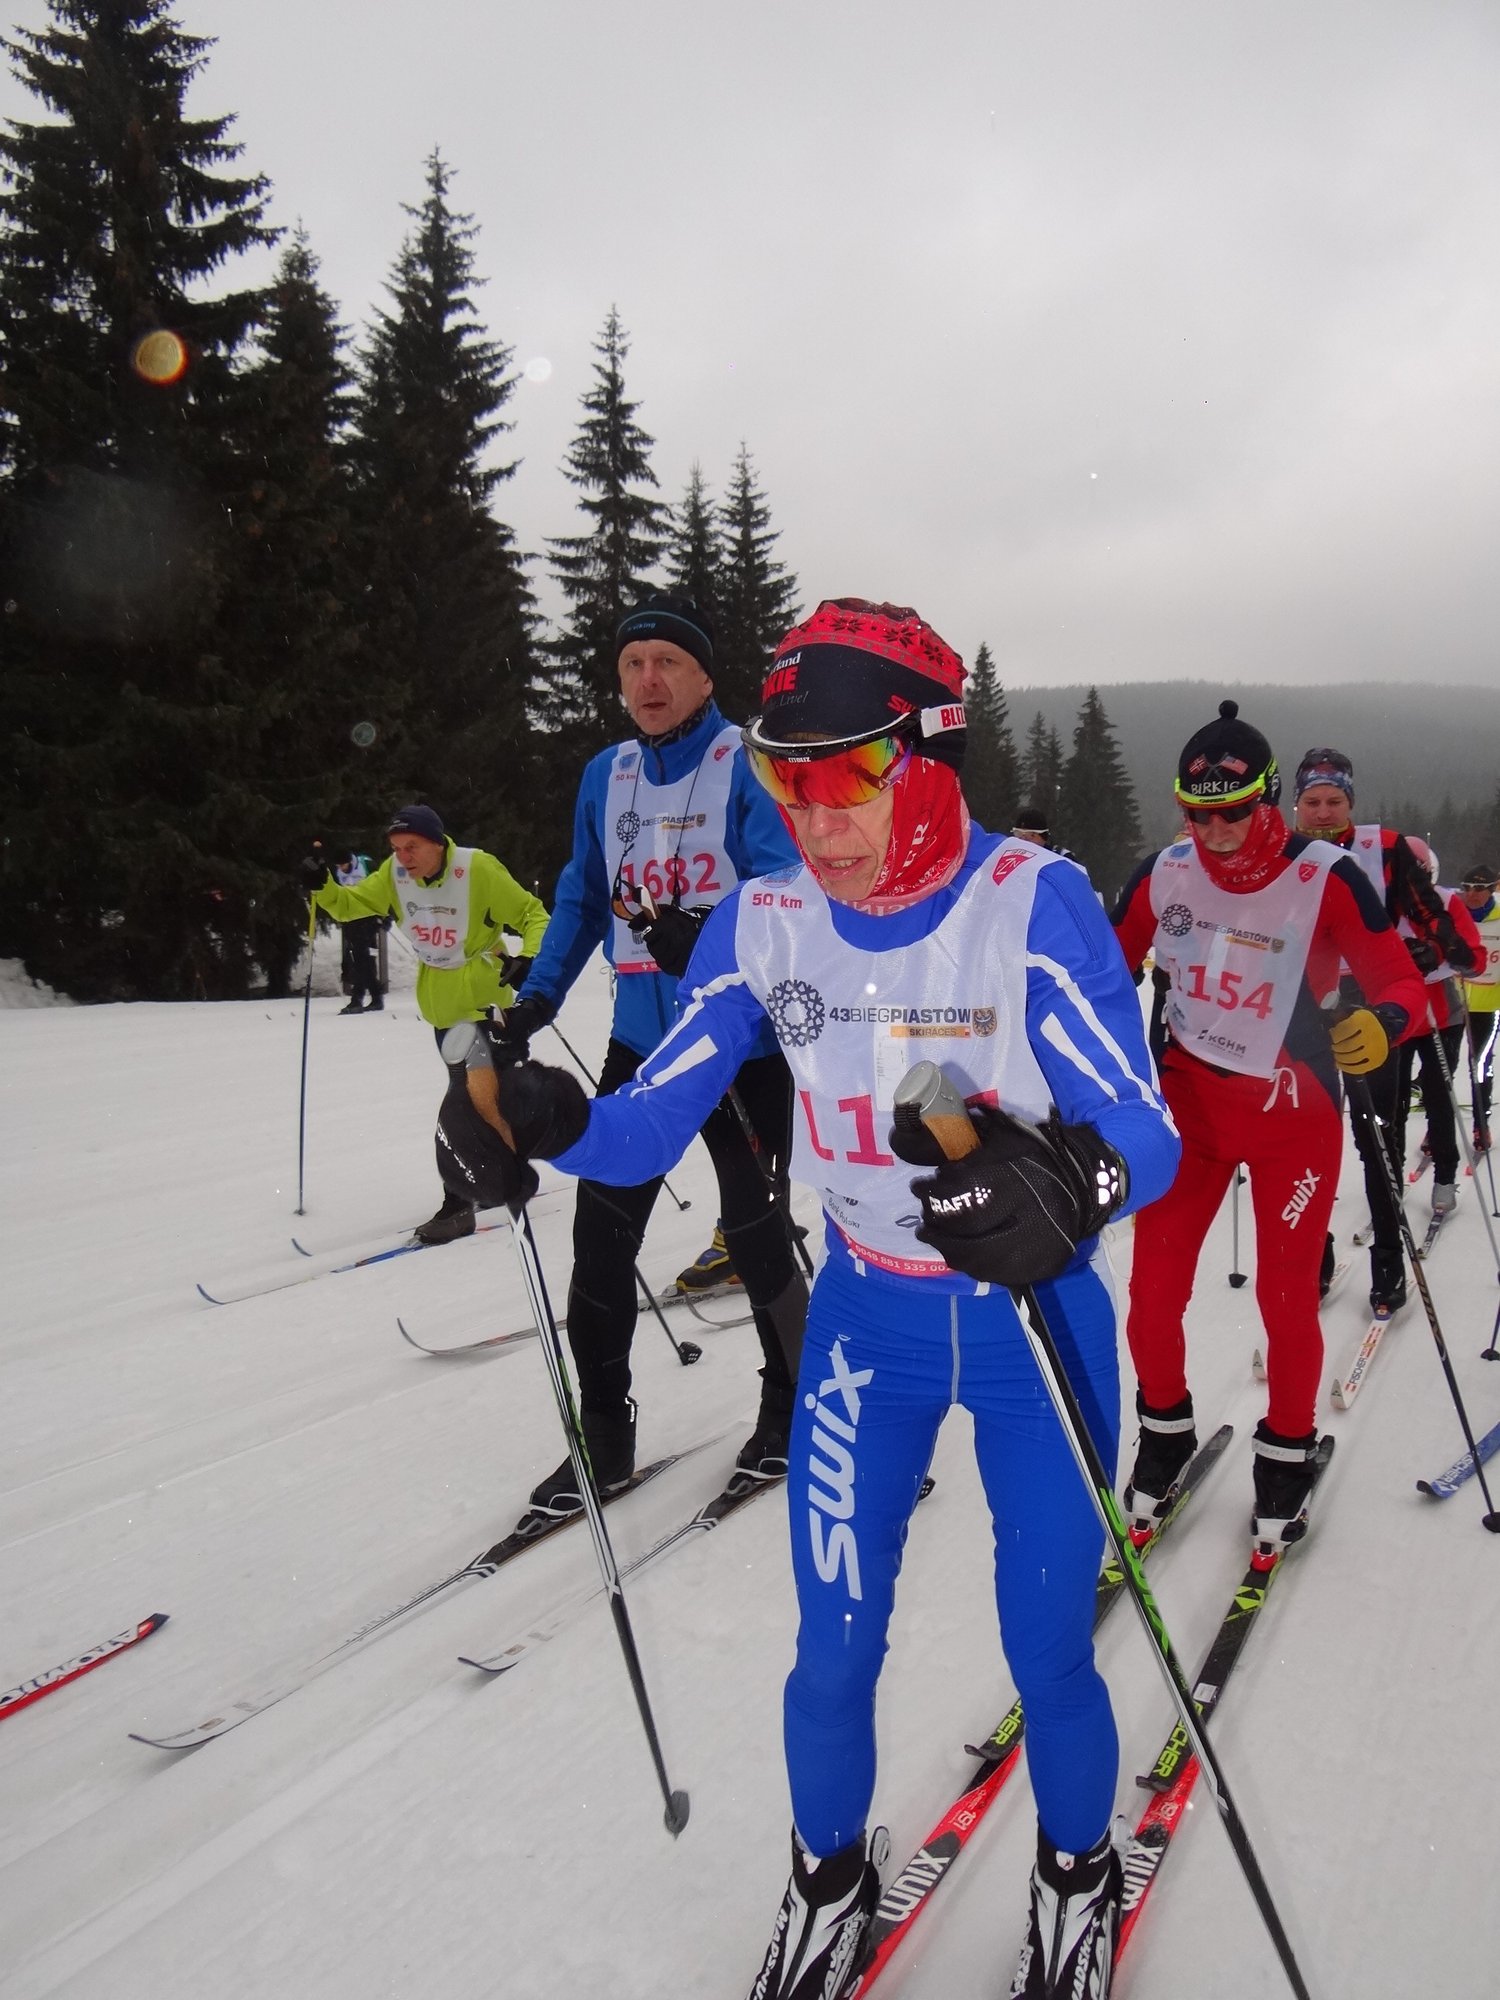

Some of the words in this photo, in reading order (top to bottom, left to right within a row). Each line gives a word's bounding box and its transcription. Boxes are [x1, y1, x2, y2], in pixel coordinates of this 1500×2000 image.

[1190, 781, 1240, 795] BIRKIE
[622, 852, 721, 903] 1682
[752, 893, 774, 906] 50
[780, 894, 803, 909] km
[880, 1256, 901, 1269] 881
[903, 1261, 927, 1272] 535
